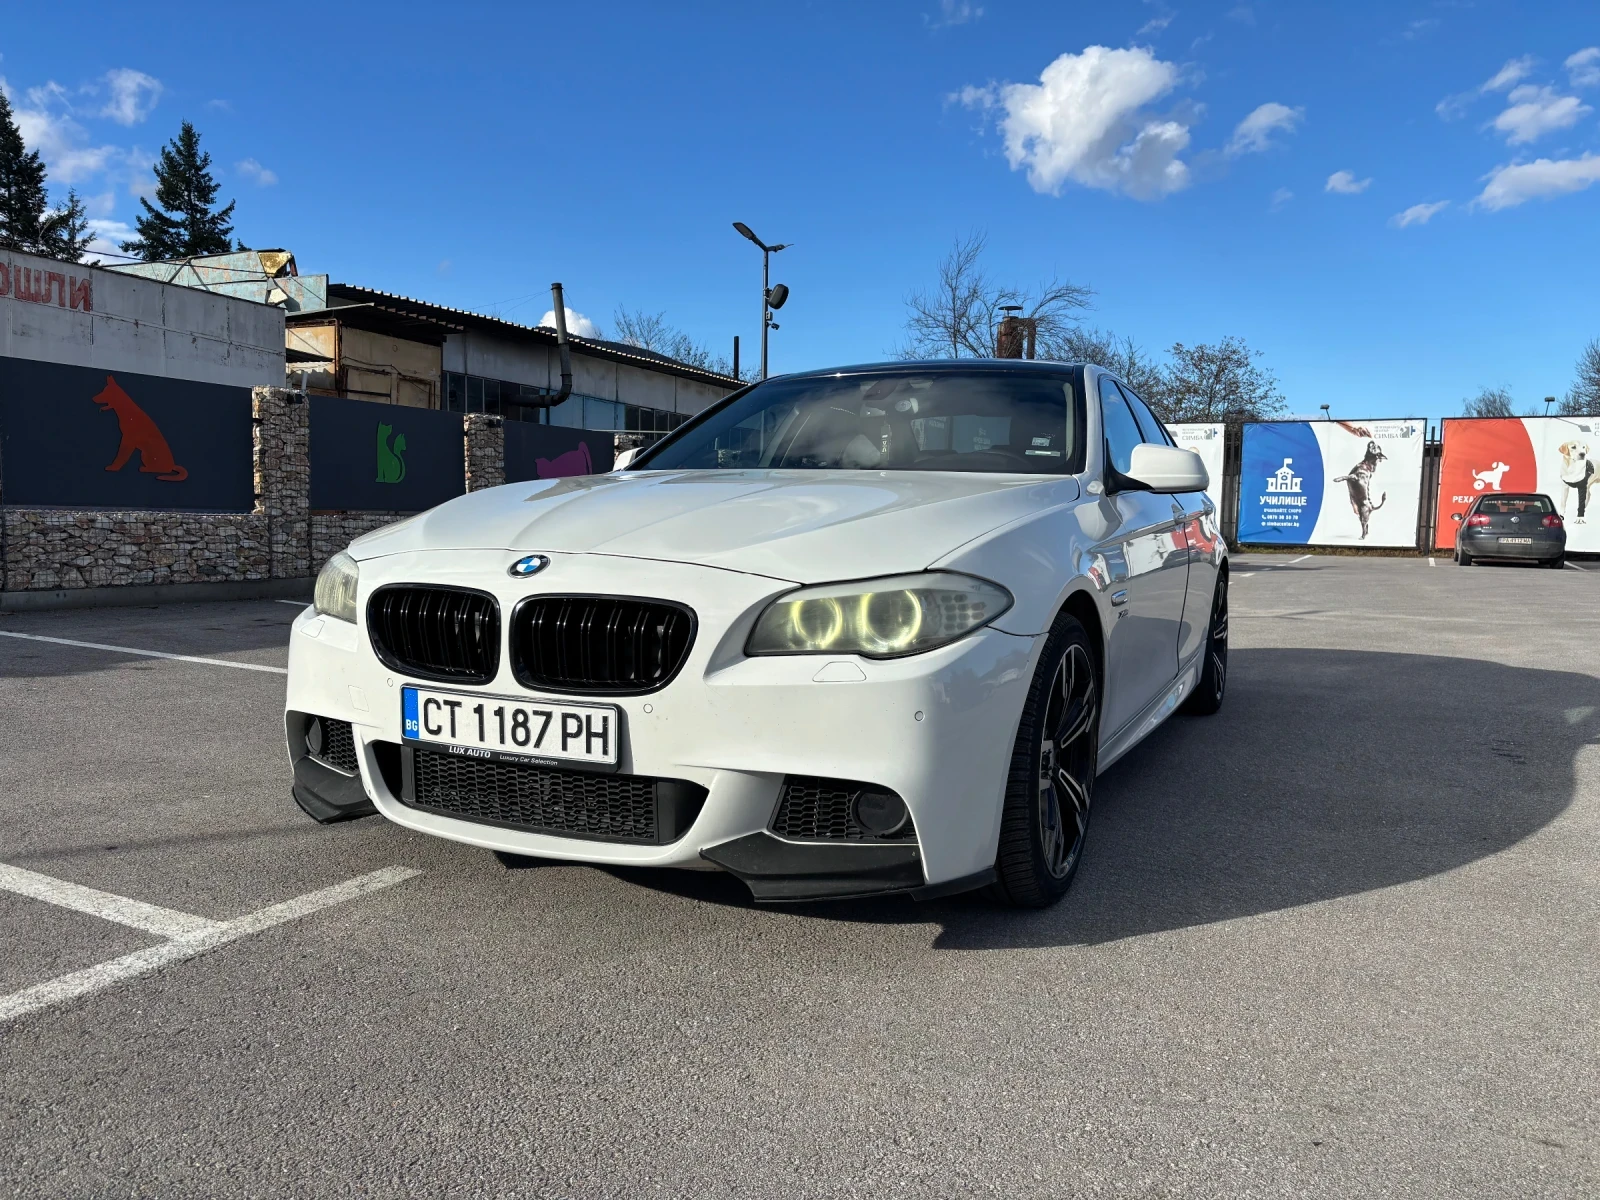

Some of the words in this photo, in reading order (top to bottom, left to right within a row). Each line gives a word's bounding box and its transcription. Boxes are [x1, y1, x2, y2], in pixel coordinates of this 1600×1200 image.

[1259, 495, 1308, 507] УЧИЛИЩЕ
[1452, 495, 1477, 504] РЕХА
[405, 719, 418, 732] BG
[423, 697, 462, 739] CT
[473, 703, 553, 749] 1187
[561, 712, 609, 756] PH
[449, 745, 465, 755] LUX
[467, 748, 491, 759] AUTO
[499, 754, 518, 762] Luxury
[531, 757, 558, 766] Selection
